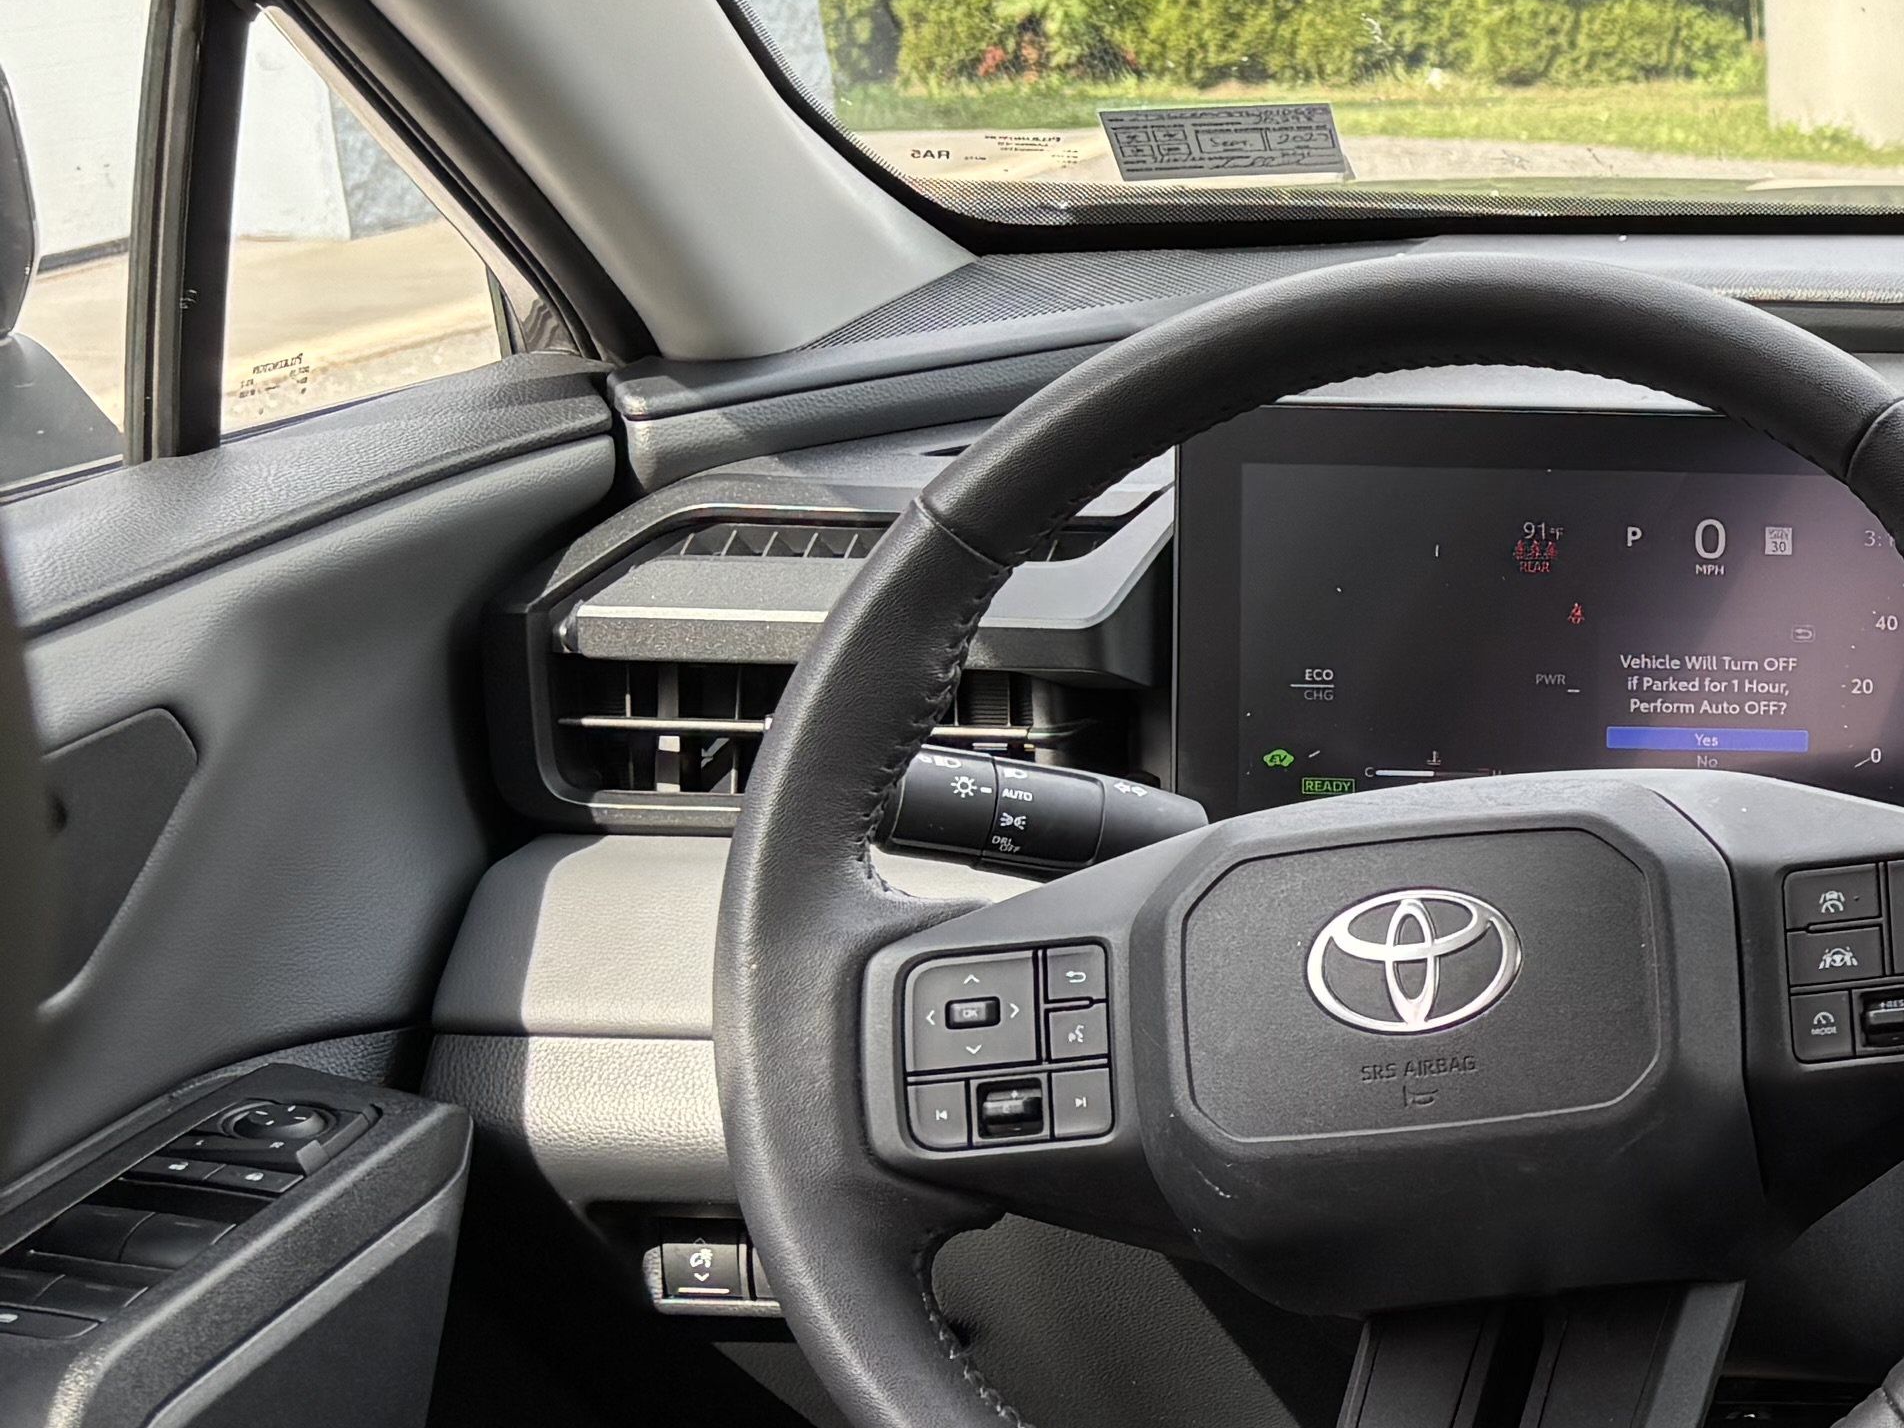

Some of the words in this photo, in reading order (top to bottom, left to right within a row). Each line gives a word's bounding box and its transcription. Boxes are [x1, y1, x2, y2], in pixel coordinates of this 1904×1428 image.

[1627, 527, 1643, 547] P
[1695, 518, 1726, 559] 0
[1772, 541, 1787, 553] 30
[1695, 564, 1725, 576] MPH
[1875, 615, 1899, 631] 40
[1620, 655, 1680, 670] Vehicle
[1685, 656, 1718, 670] Will
[1722, 657, 1759, 671] Turn
[1764, 657, 1797, 672] OFF
[1304, 669, 1334, 681] ECO
[1535, 674, 1566, 685] PWR
[1627, 677, 1638, 692] if
[1642, 678, 1699, 693] Parked
[1703, 678, 1728, 693] for
[1732, 679, 1739, 693] 1
[1744, 679, 1790, 696] Hour,
[1851, 679, 1874, 695] 20
[1303, 689, 1334, 701] CHG
[1629, 699, 1695, 714] Perform
[1699, 700, 1740, 715] Auto
[1744, 700, 1787, 715] OFF?
[1695, 734, 1719, 747] Yes
[1697, 755, 1718, 768] No
[1870, 748, 1882, 763] 0
[1305, 780, 1352, 793] READY
[1002, 788, 1033, 802] AUTO
[1360, 1063, 1397, 1081] SRS
[1403, 1054, 1477, 1080] AIRBAG
